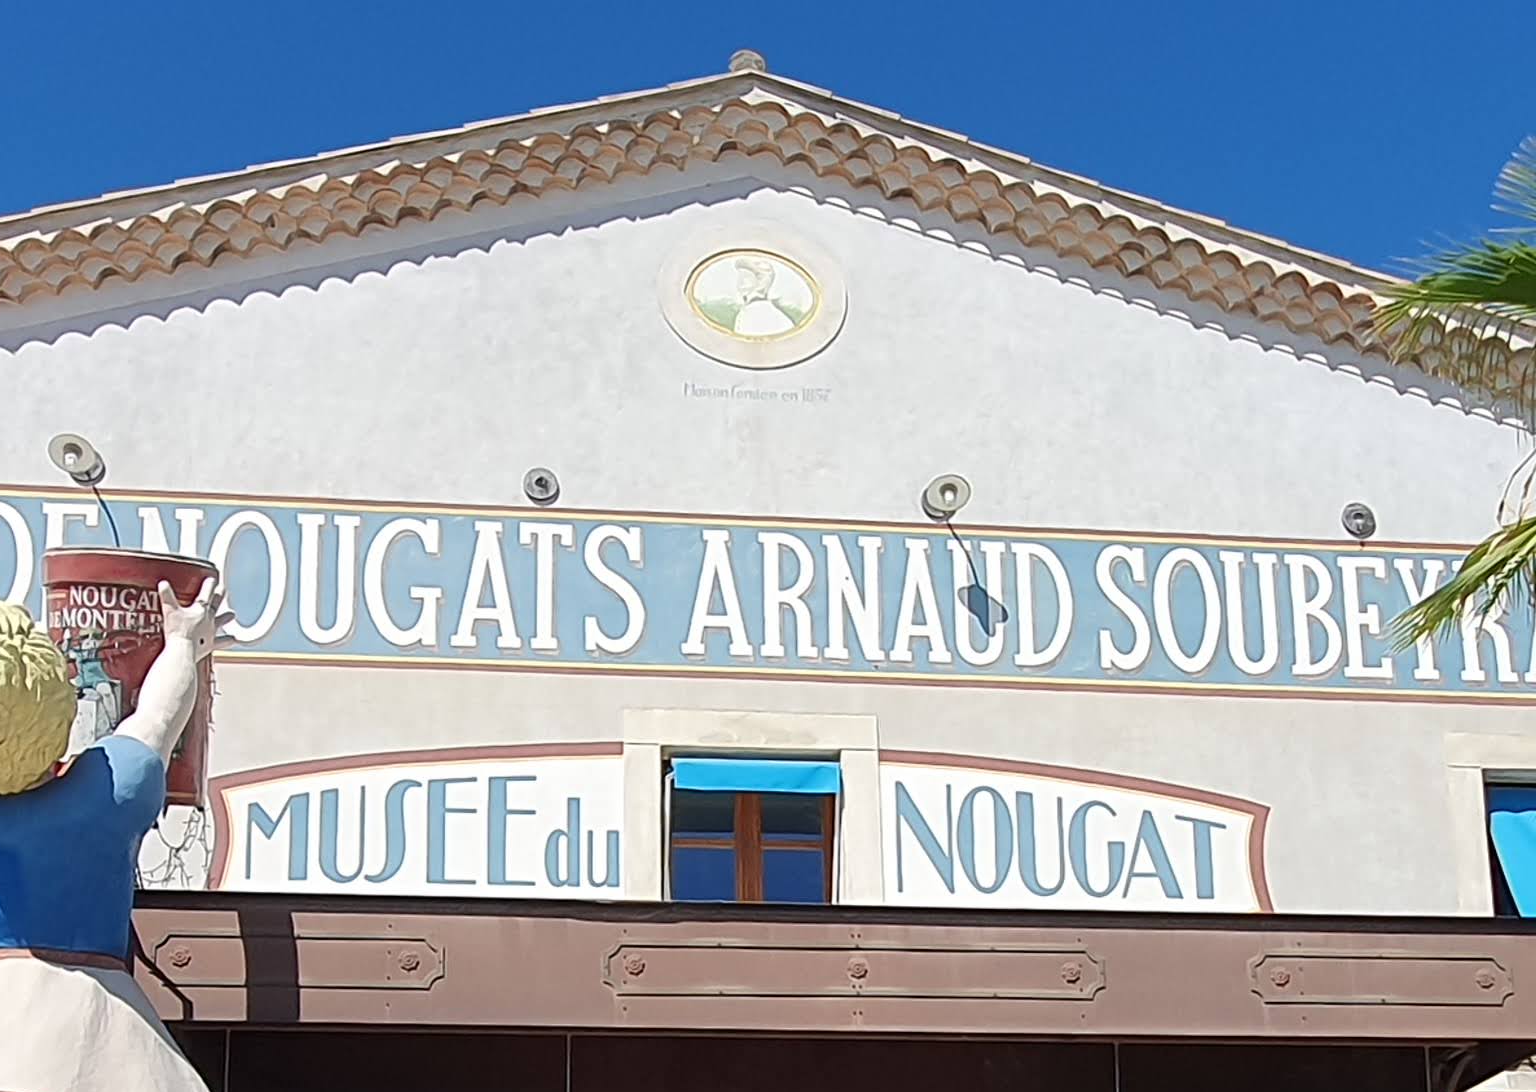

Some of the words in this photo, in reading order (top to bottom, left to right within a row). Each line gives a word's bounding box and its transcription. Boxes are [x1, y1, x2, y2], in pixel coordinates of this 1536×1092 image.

[680, 528, 1074, 669] ARNAUD
[245, 775, 537, 886] MUSEE
[544, 797, 620, 888] du
[895, 780, 1227, 898] NOUGAT
